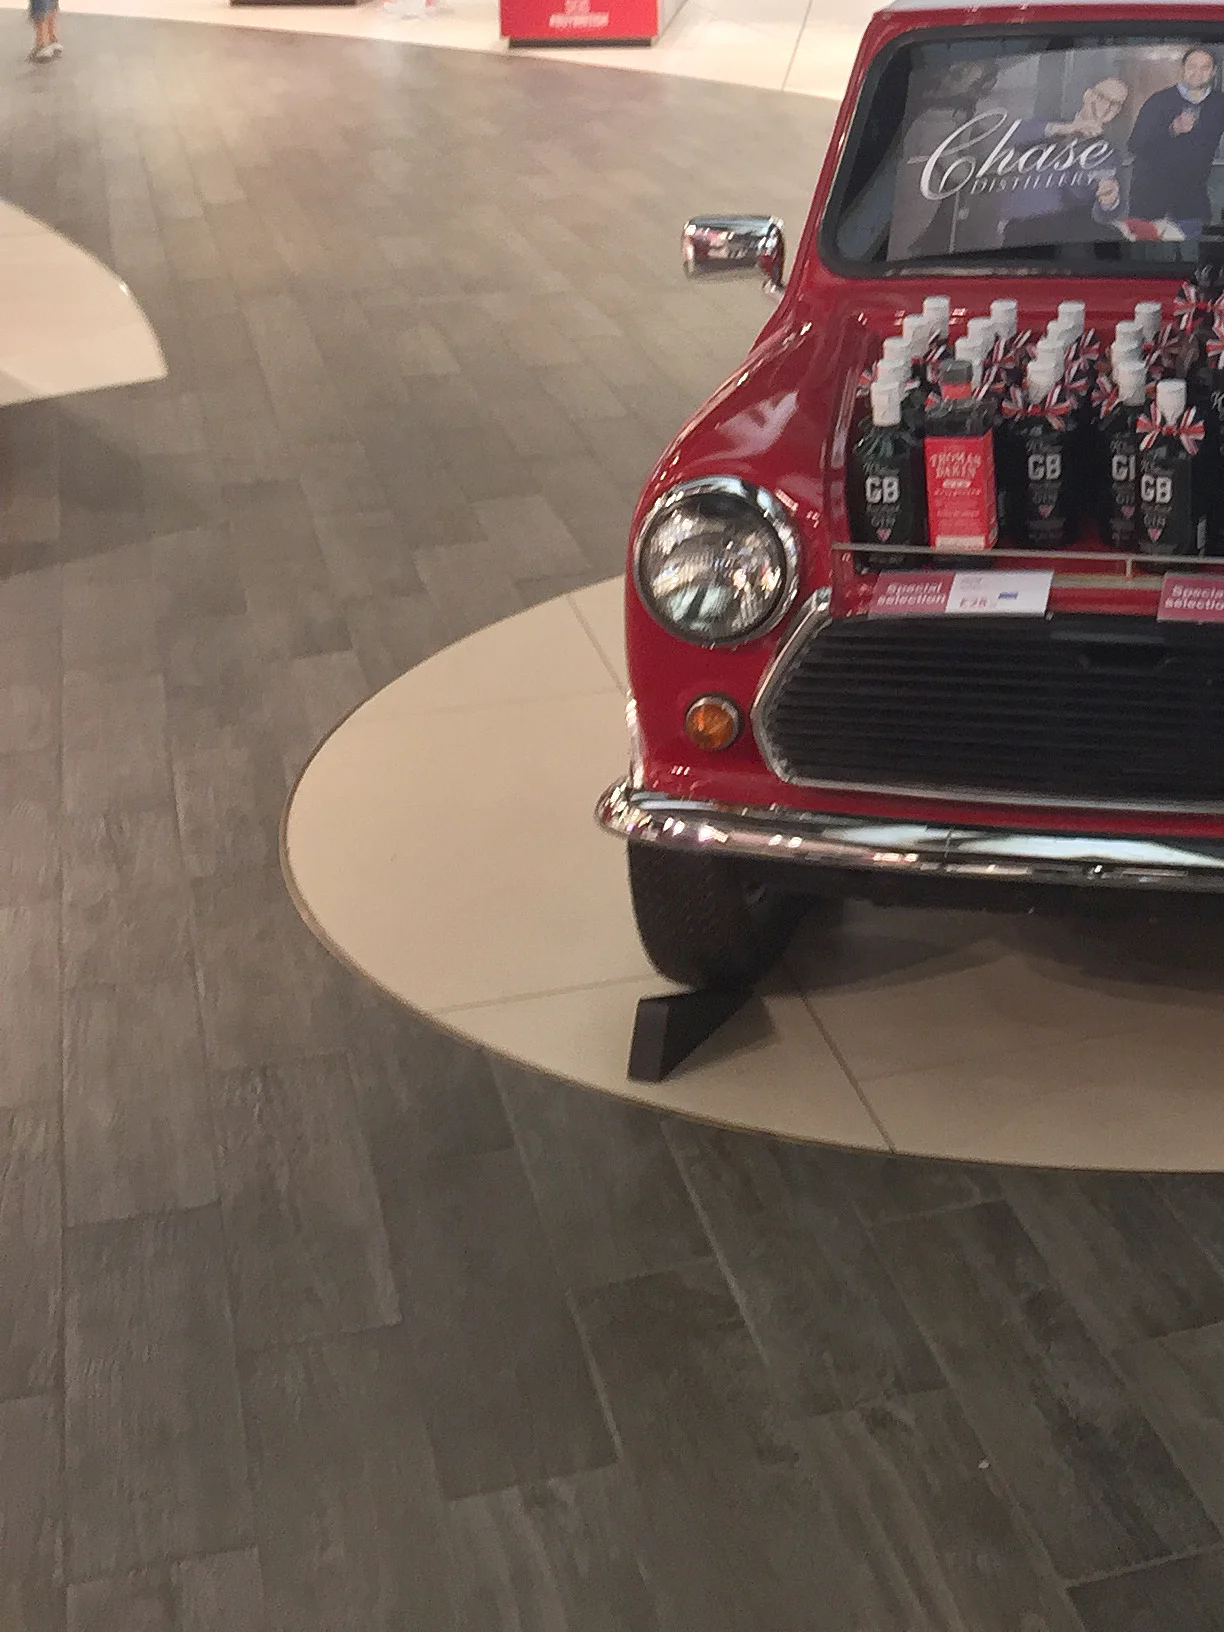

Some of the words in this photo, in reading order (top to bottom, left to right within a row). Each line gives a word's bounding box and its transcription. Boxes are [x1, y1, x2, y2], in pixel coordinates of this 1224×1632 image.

[919, 107, 1115, 201] Chase
[1028, 453, 1062, 481] GB
[865, 476, 900, 504] GB
[1140, 474, 1173, 505] GB
[877, 594, 947, 608] selection
[886, 582, 942, 596] Special
